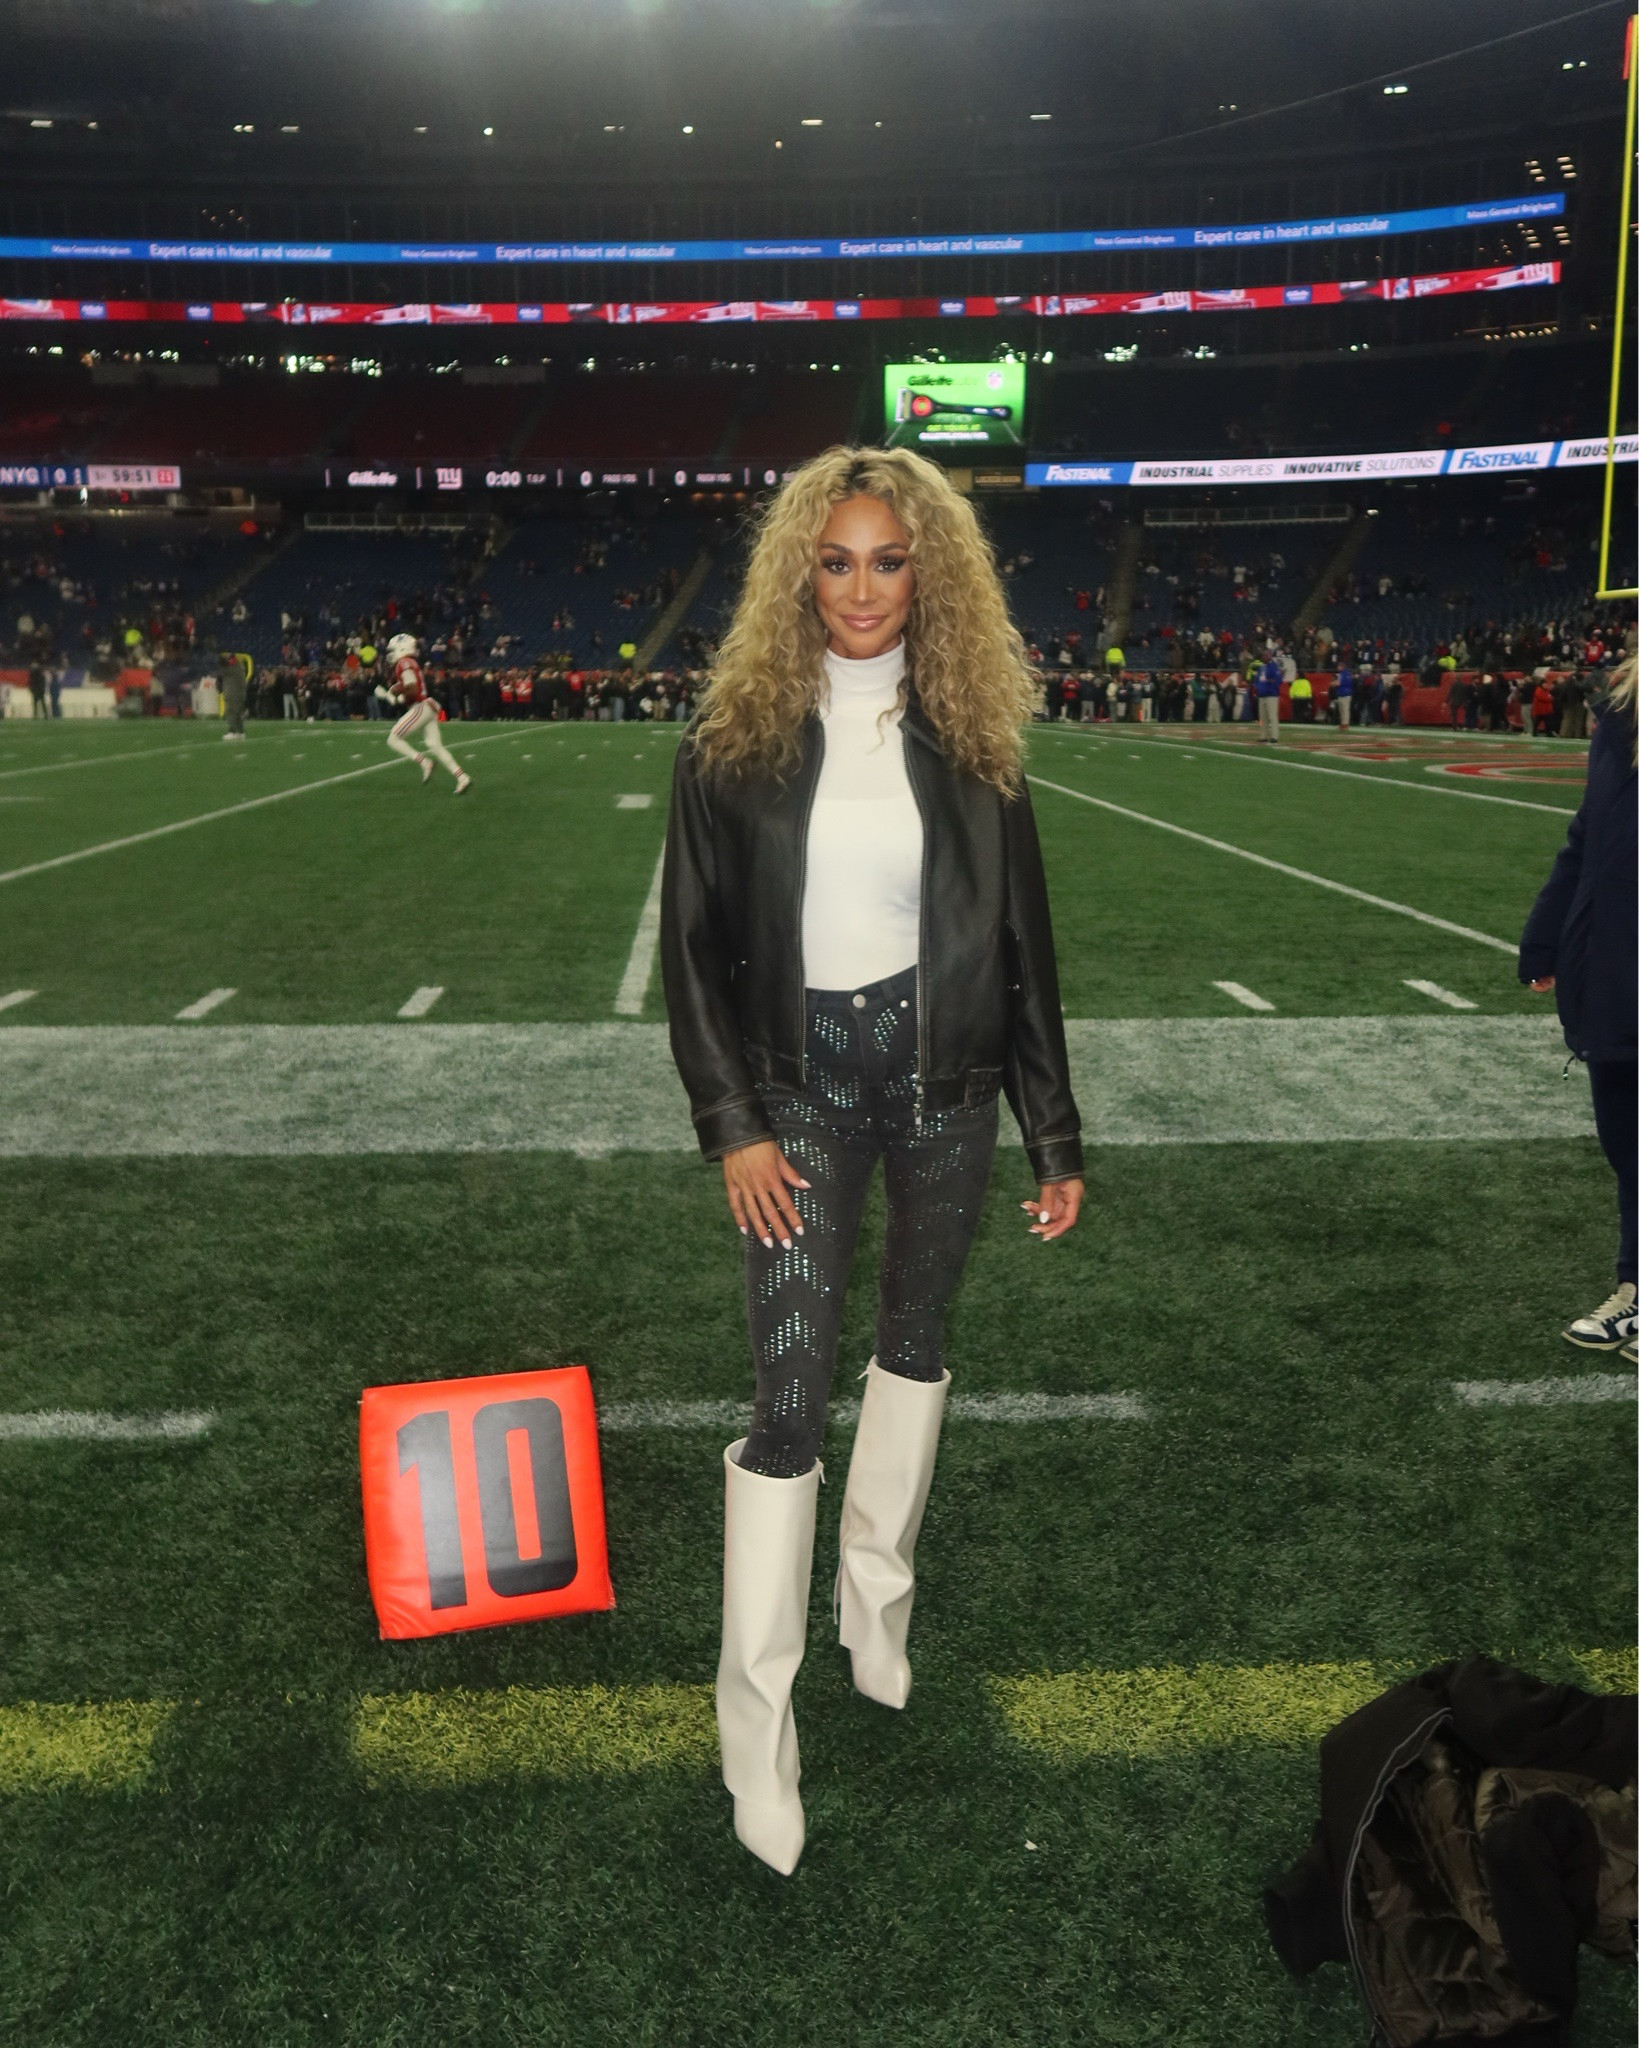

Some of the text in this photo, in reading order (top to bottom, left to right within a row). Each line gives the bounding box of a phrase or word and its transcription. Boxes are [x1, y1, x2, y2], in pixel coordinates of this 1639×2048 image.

[1194, 218, 1390, 246] Expert care in heart and vascular
[150, 243, 332, 260] Expert care in heart and vascular
[495, 245, 676, 260] Expert care in heart and vascular
[839, 238, 1023, 256] Expert care in heart and vascular
[0, 466, 39, 485] NYG
[1139, 456, 1437, 478] INDUSTRIAL SUPPLIES INNOVATIVE SOLUTIONS
[348, 471, 398, 486] Gillette
[486, 470, 522, 487] 0:00
[580, 470, 592, 487] 0
[674, 470, 687, 486] 0
[764, 469, 776, 486] 0
[396, 1397, 578, 1611] 10
